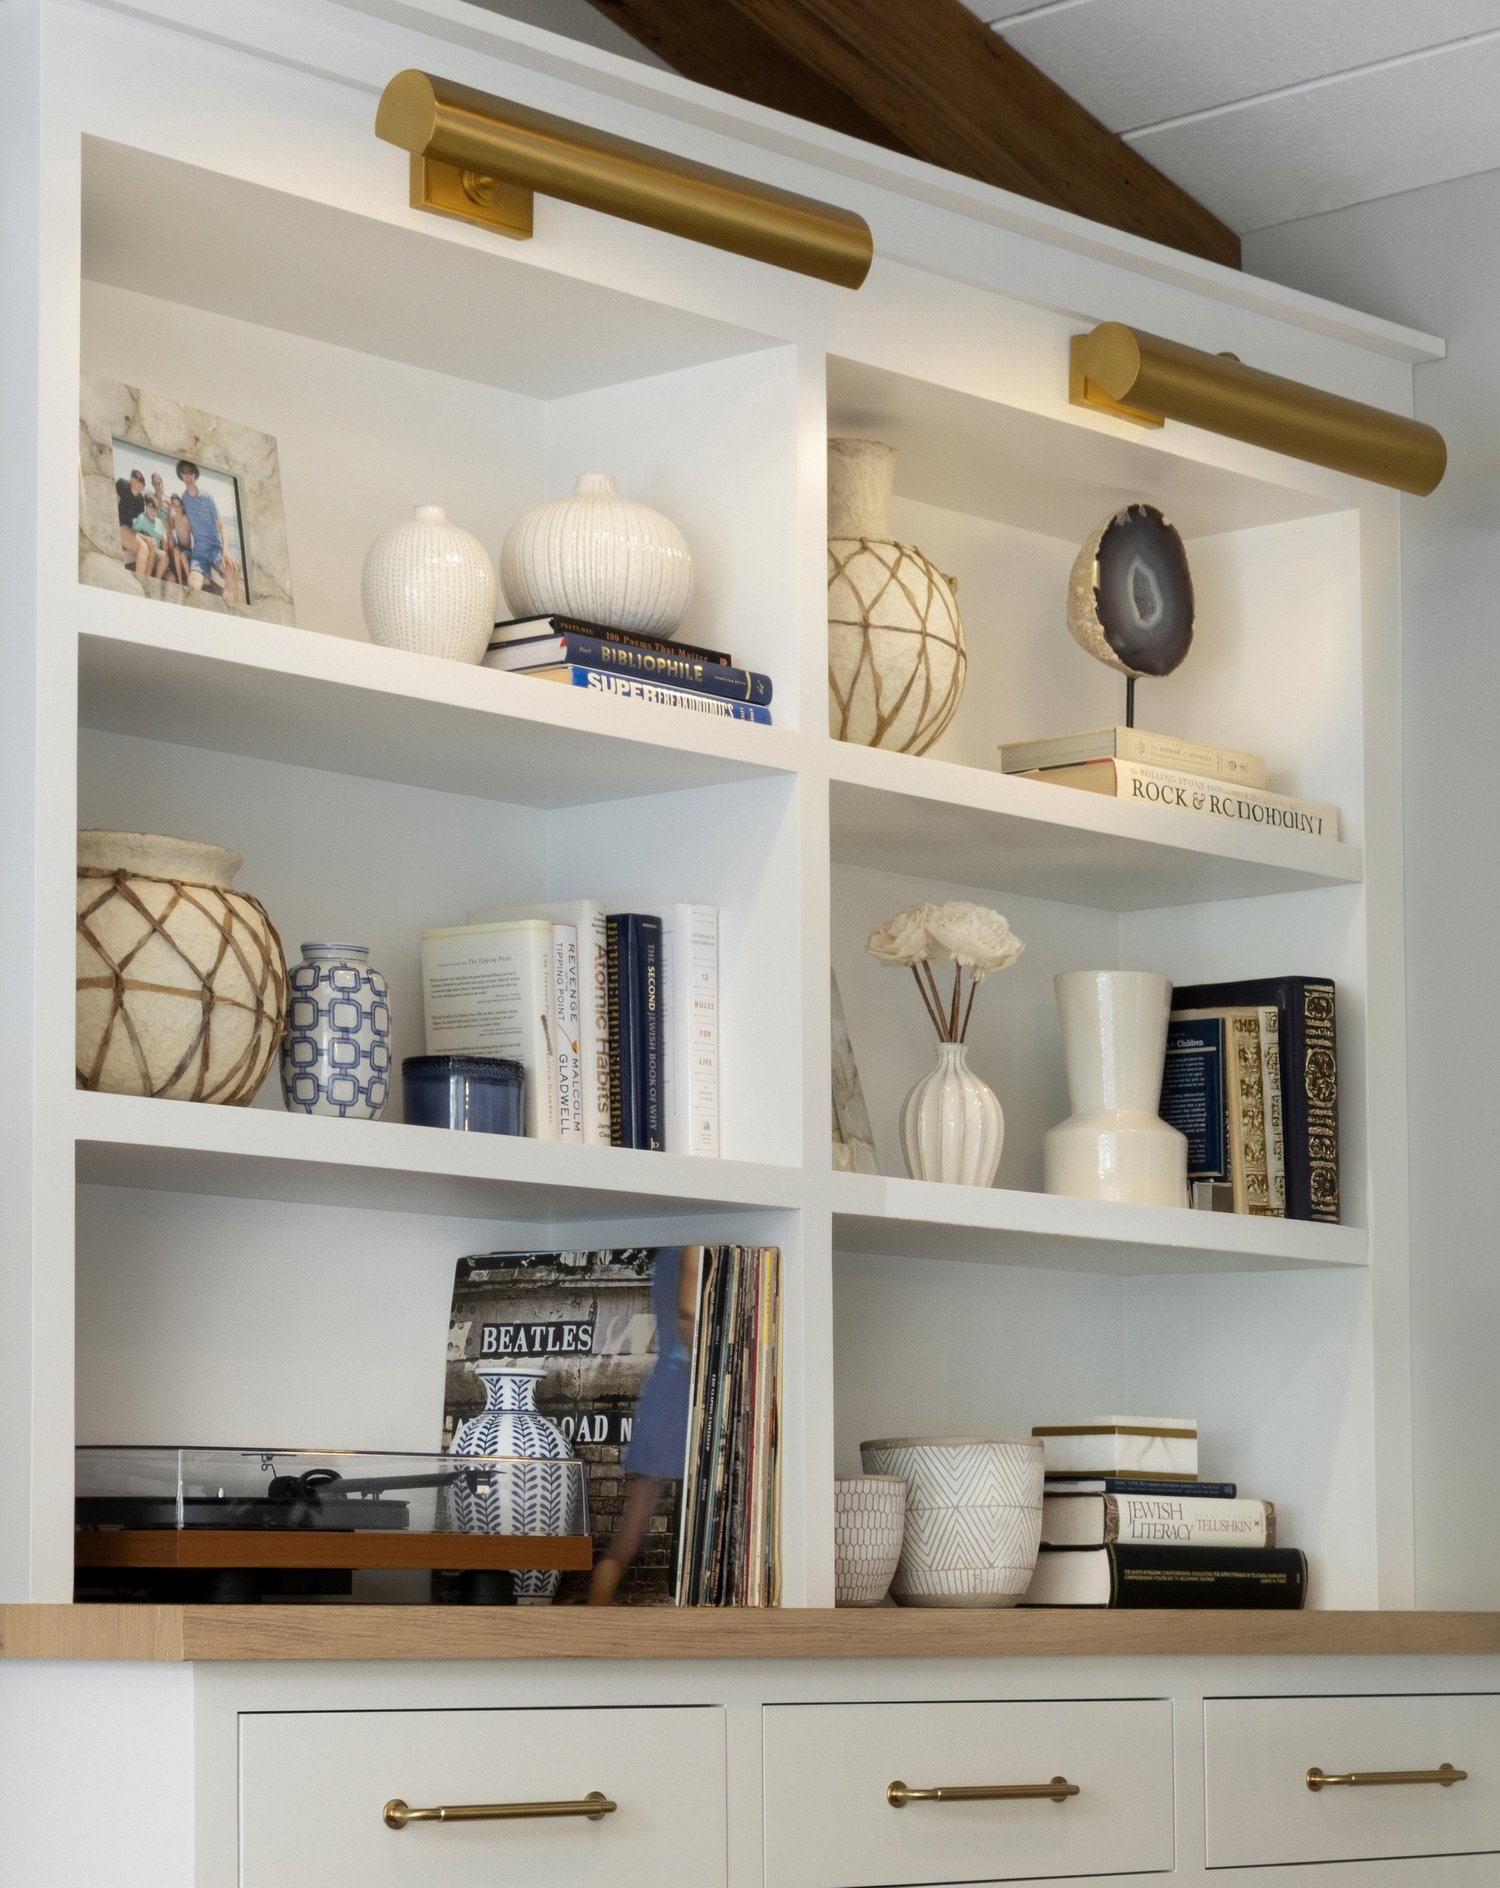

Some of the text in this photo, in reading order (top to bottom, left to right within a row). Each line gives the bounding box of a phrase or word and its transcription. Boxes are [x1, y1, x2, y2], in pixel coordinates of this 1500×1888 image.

[606, 631, 709, 663] 100 Poems That Matter
[601, 645, 703, 683] BIBLIOPHILE
[1131, 778, 1206, 810] ROCK &
[1140, 769, 1177, 783] ROLLING
[1178, 777, 1206, 791] STONE
[647, 944, 655, 964] THE
[556, 943, 565, 1021] TIPPING POINT
[568, 943, 578, 1022] REVENGE
[594, 942, 608, 1030] Atomic
[647, 965, 656, 1011] SECOND
[702, 973, 709, 981] 12
[694, 1000, 715, 1010] RULES
[647, 1012, 657, 1050] JEWISH
[699, 1030, 711, 1038] FOR
[1176, 1038, 1204, 1048] Children
[595, 1038, 610, 1114] Habits
[648, 1053, 657, 1086] BOOK
[699, 1059, 712, 1067] LIFE
[558, 1053, 570, 1135] GLADWELL
[572, 1058, 581, 1132] MALCOLM
[649, 1087, 657, 1102] OF
[481, 1325, 593, 1353] BEATLES
[1126, 1501, 1183, 1527] JEWISH
[1196, 1519, 1252, 1533] TELUSHKIN
[1131, 1521, 1194, 1541] LITERACY
